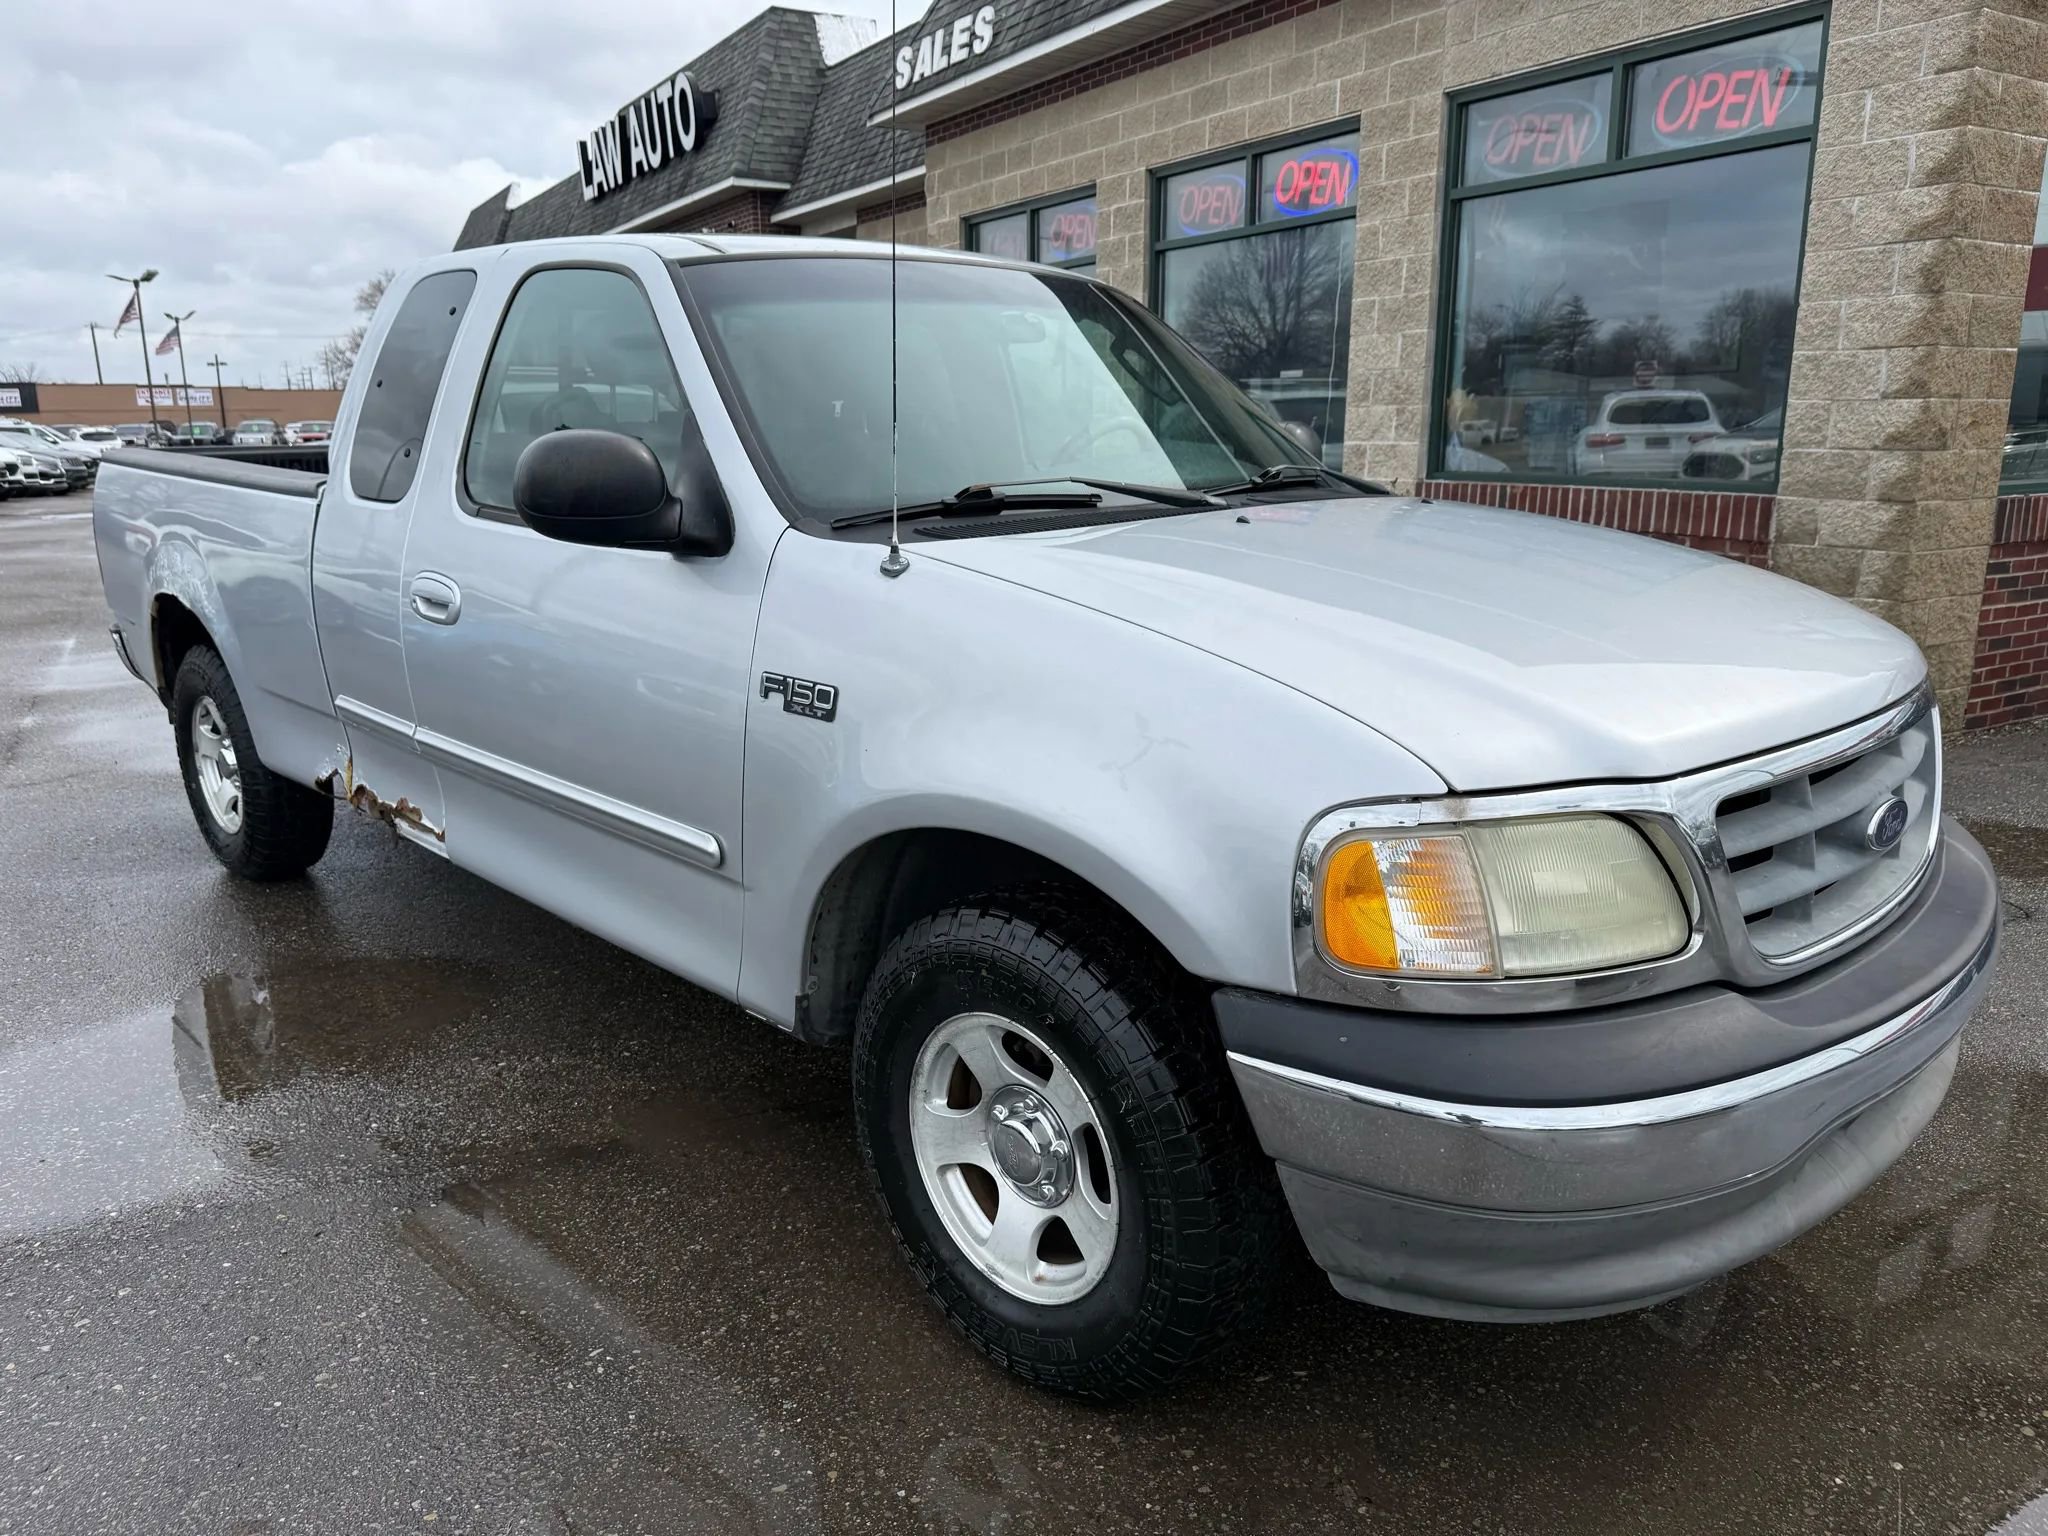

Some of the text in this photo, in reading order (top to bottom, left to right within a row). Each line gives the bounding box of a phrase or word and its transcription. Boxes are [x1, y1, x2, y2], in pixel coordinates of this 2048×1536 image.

[895, 5, 996, 90] SALES
[1654, 66, 1794, 135] OPEN
[576, 71, 698, 202] LAW AUTO
[1485, 113, 1593, 165] OPEN
[1178, 184, 1243, 226] OPEN
[1275, 159, 1351, 206] OPEN
[1051, 213, 1097, 250] OPEN
[790, 703, 827, 717] XLT
